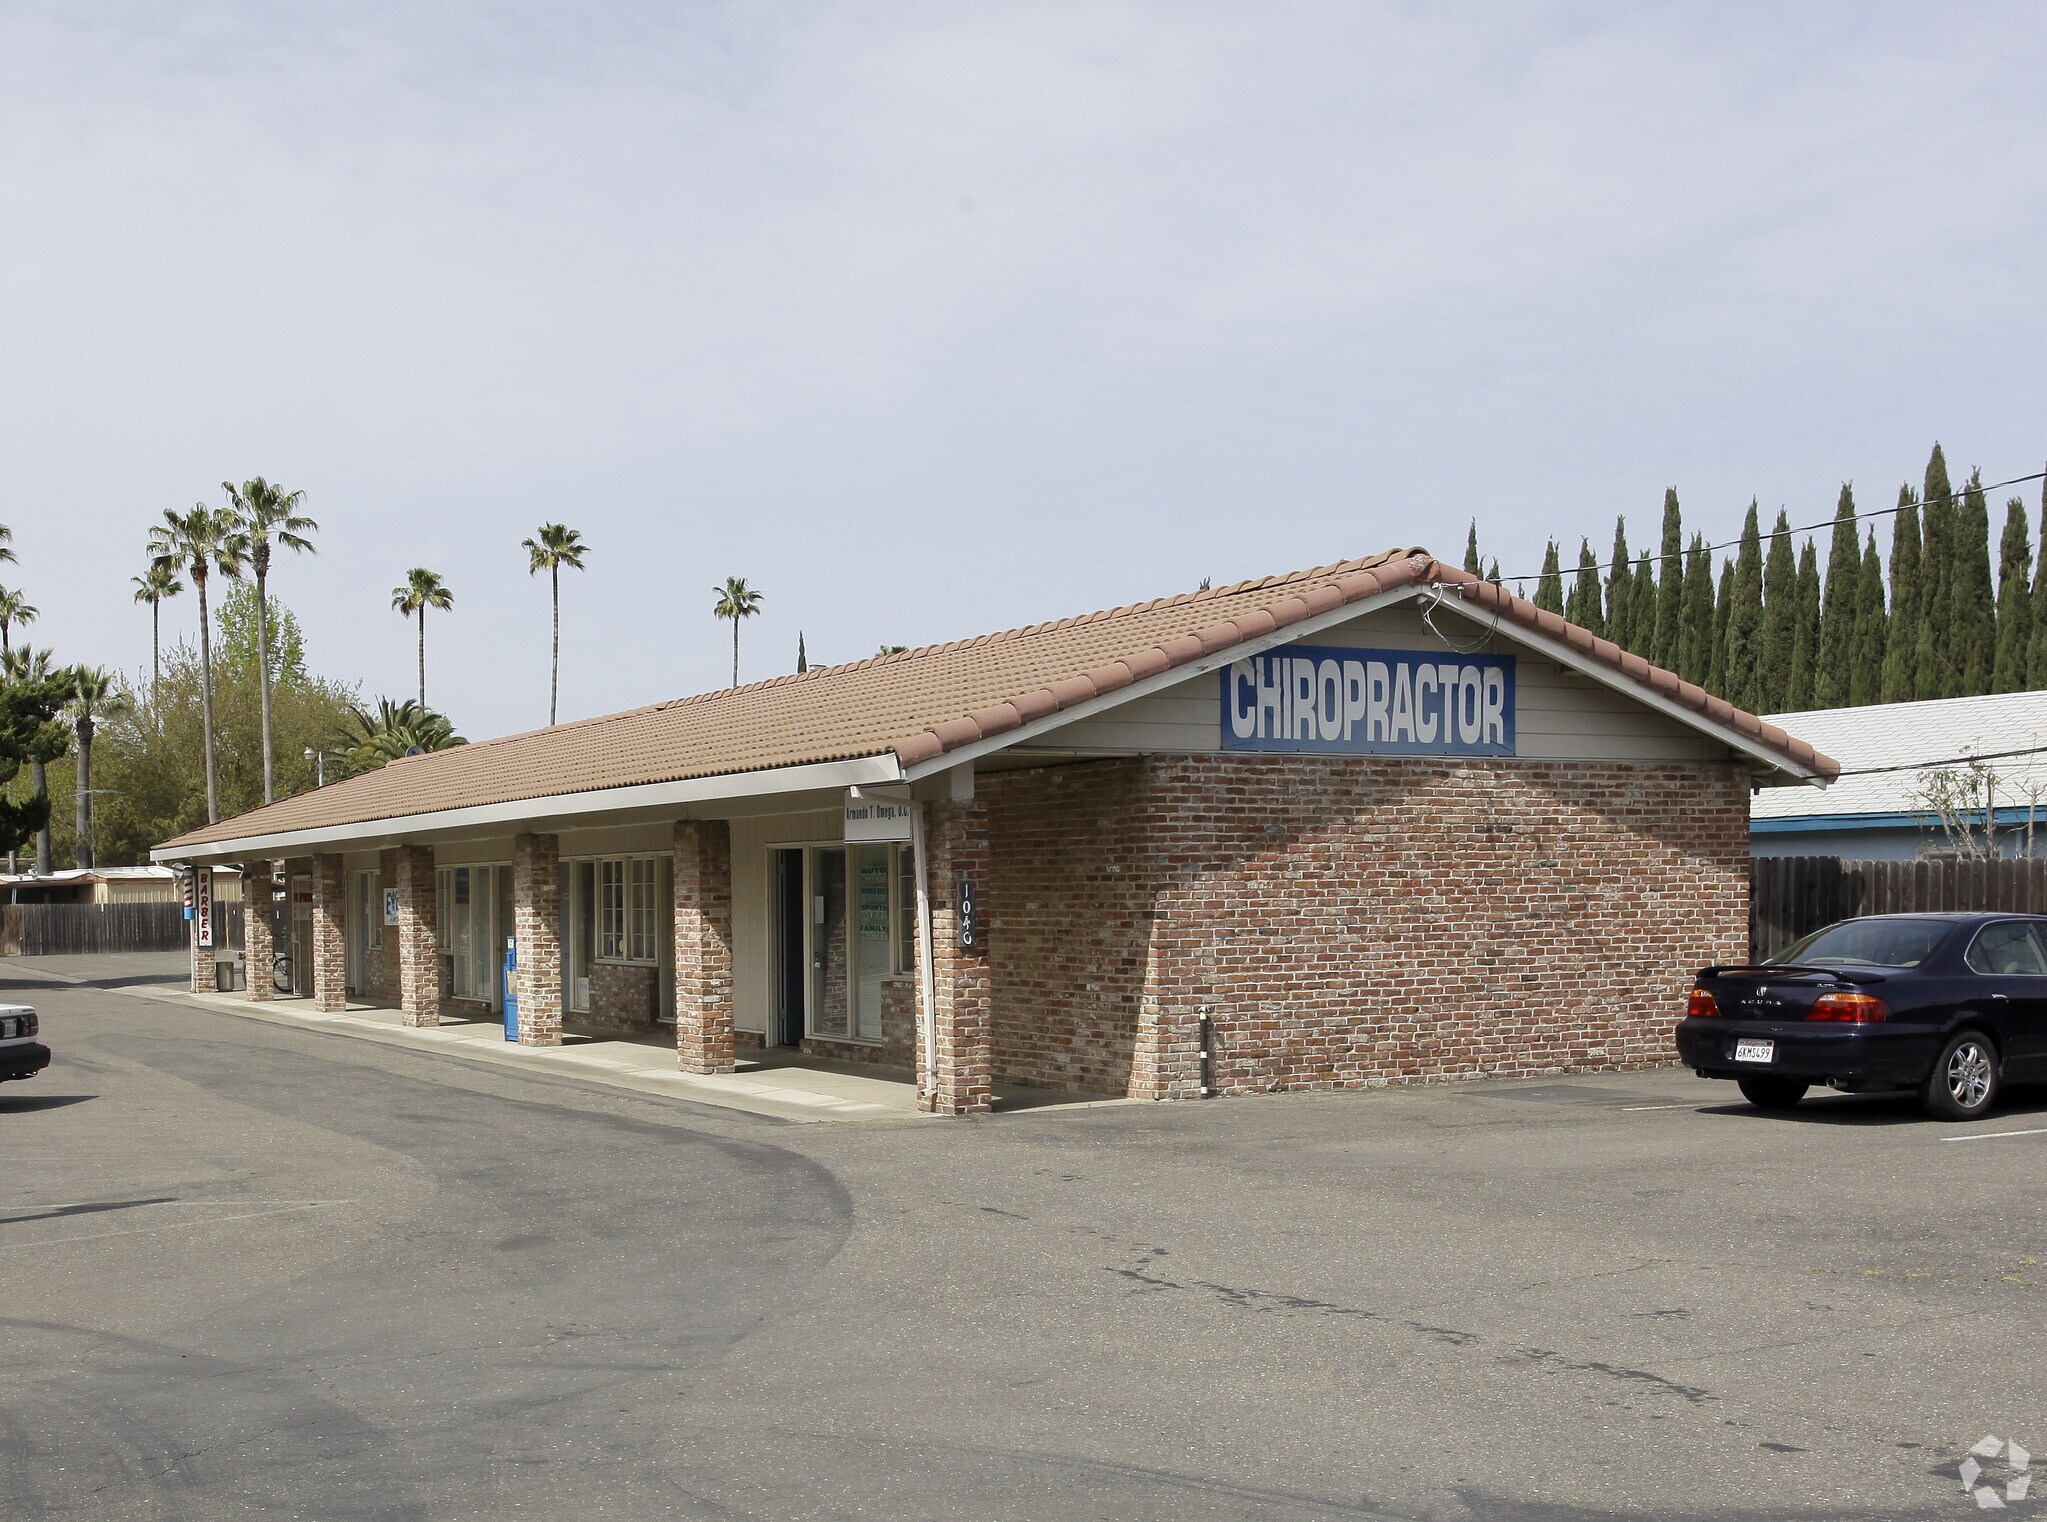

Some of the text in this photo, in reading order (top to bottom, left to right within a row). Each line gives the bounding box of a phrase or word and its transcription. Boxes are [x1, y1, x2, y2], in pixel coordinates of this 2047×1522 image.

[1230, 656, 1504, 744] CHIROPRACTOR
[846, 807, 868, 820] Armando
[869, 805, 875, 819] T.
[200, 873, 211, 940] BARBER
[860, 925, 886, 933] FAMILY
